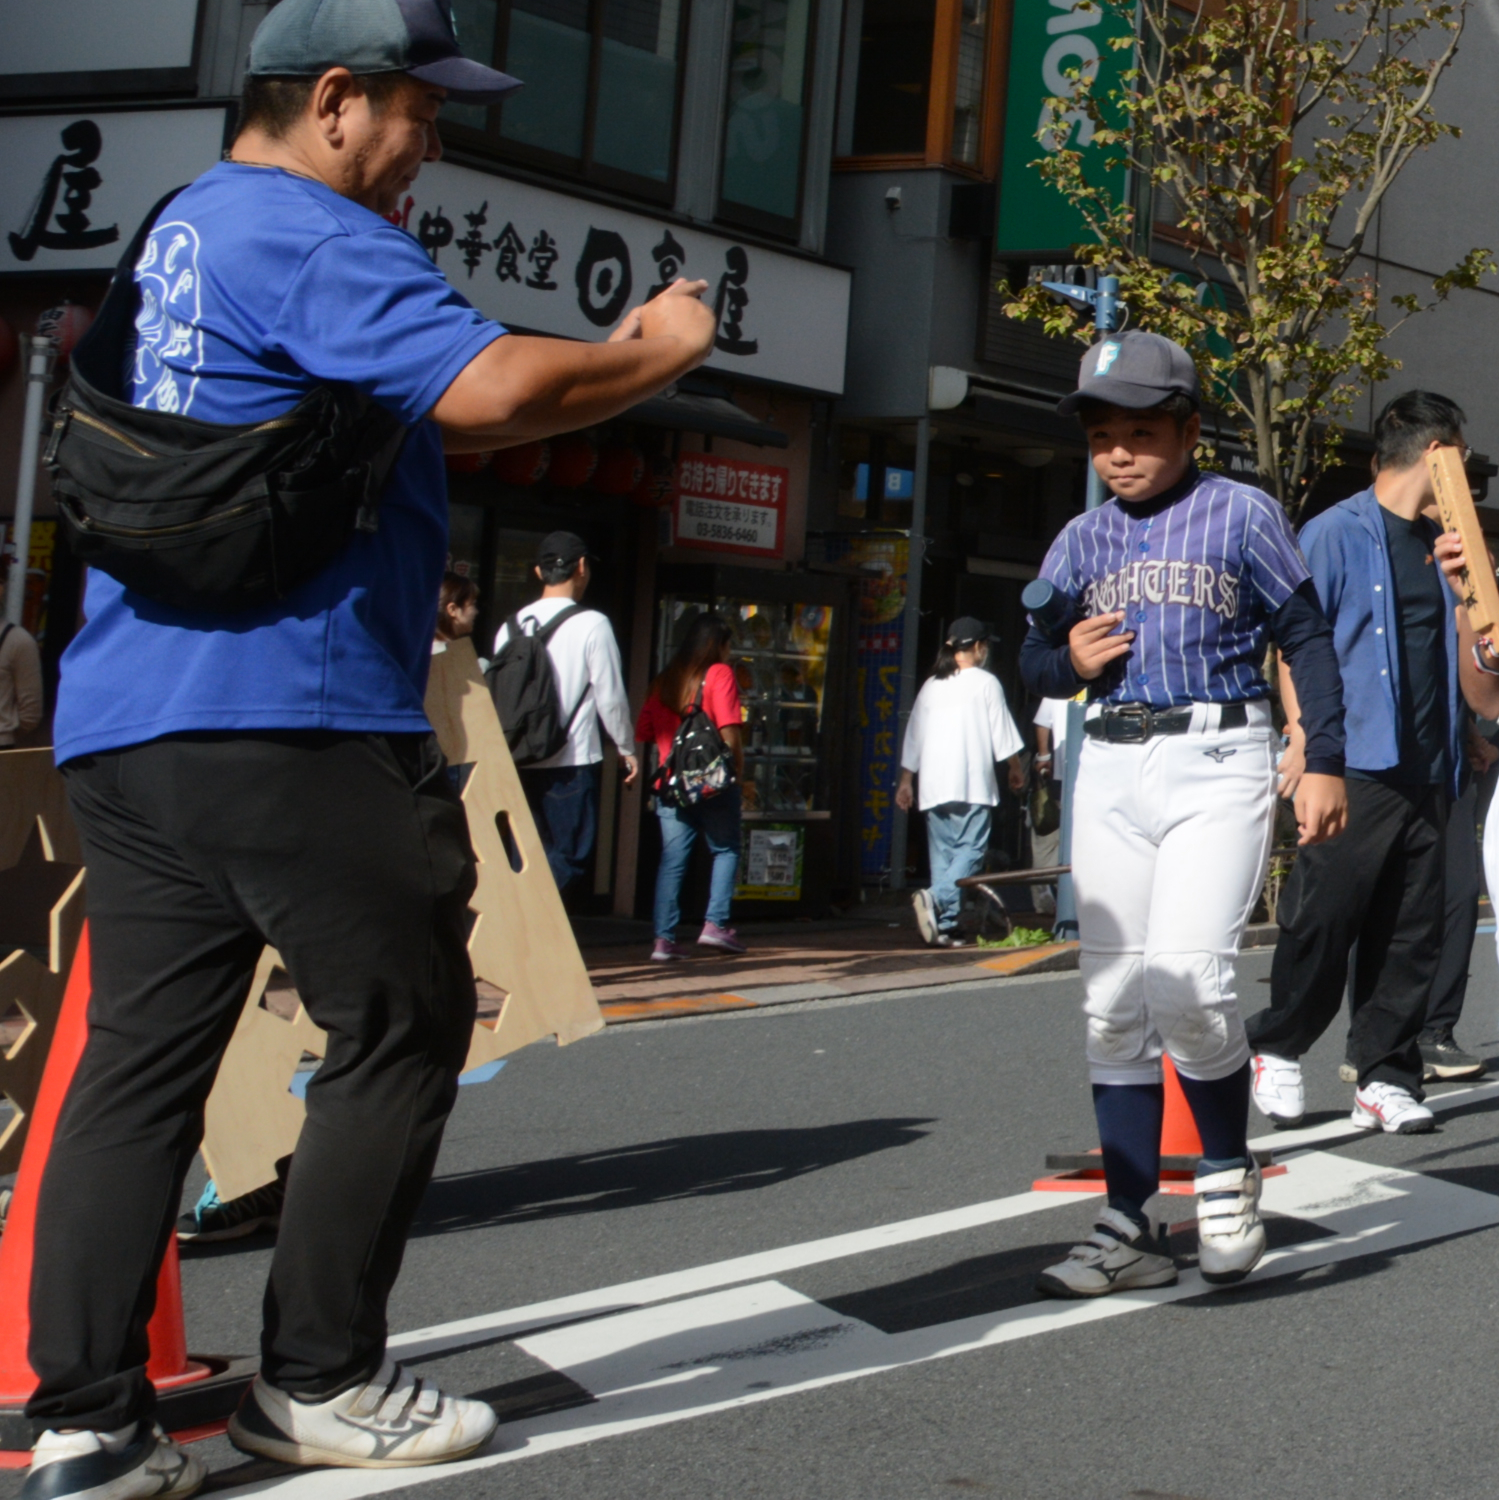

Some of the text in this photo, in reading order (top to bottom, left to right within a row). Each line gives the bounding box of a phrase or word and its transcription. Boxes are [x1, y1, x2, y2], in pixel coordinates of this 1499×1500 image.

[418, 201, 558, 291] 中華食堂
[680, 459, 782, 503] お持ち帰りできます
